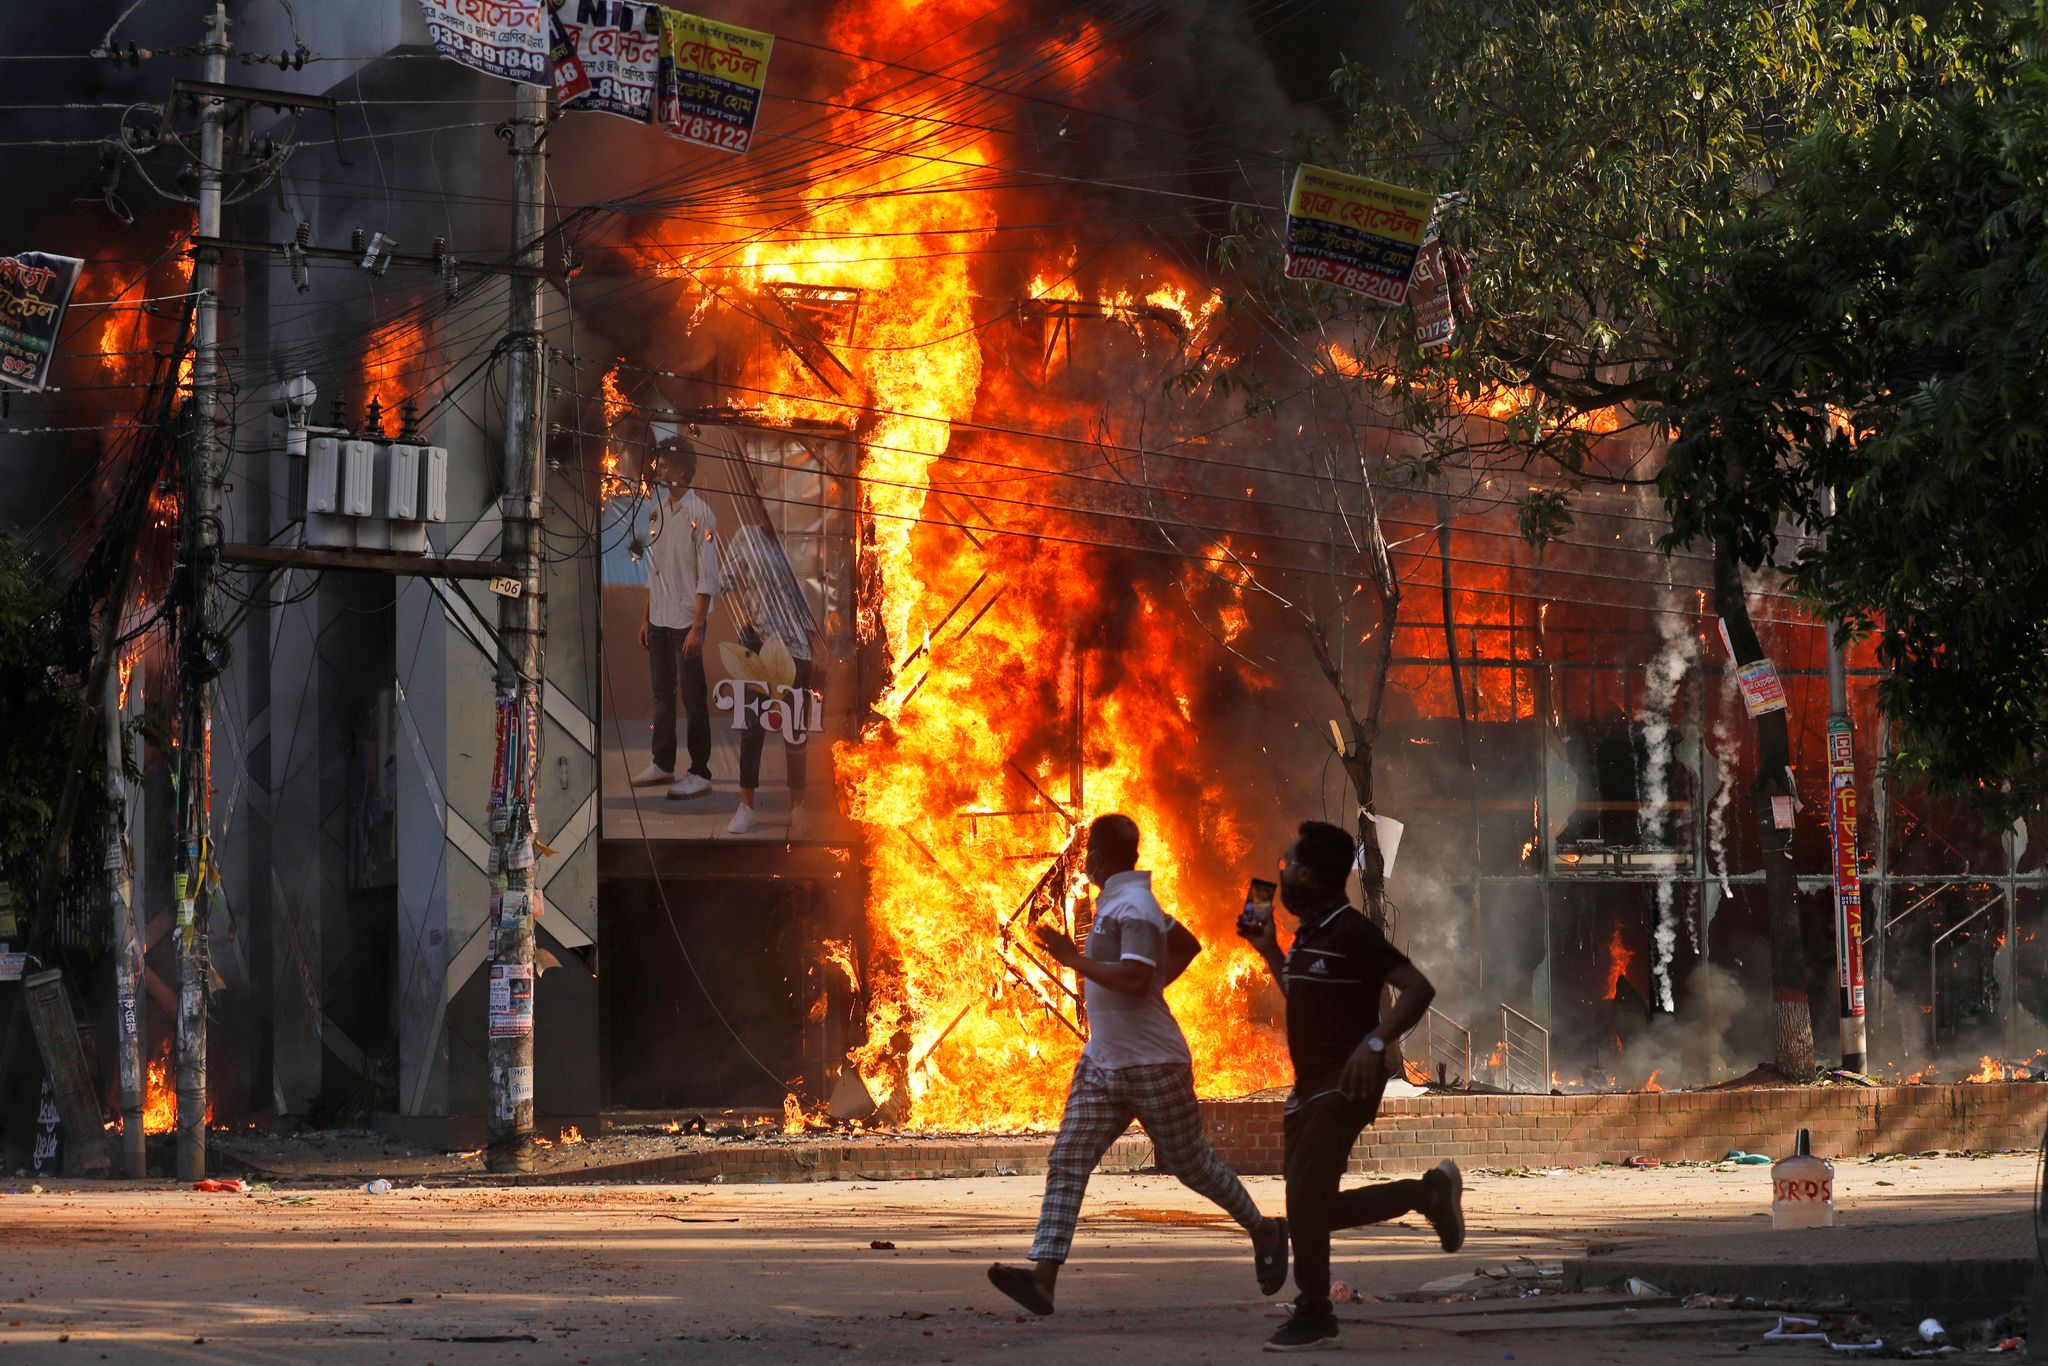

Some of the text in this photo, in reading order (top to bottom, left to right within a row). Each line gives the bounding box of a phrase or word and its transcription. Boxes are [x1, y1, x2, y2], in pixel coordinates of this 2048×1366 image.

[680, 41, 762, 83] হোস্টেল
[680, 114, 749, 151] 785122
[1340, 200, 1424, 240] হোস্টেল
[2, 355, 37, 380] 892
[495, 577, 520, 595] T-06
[712, 679, 824, 745] Fall
